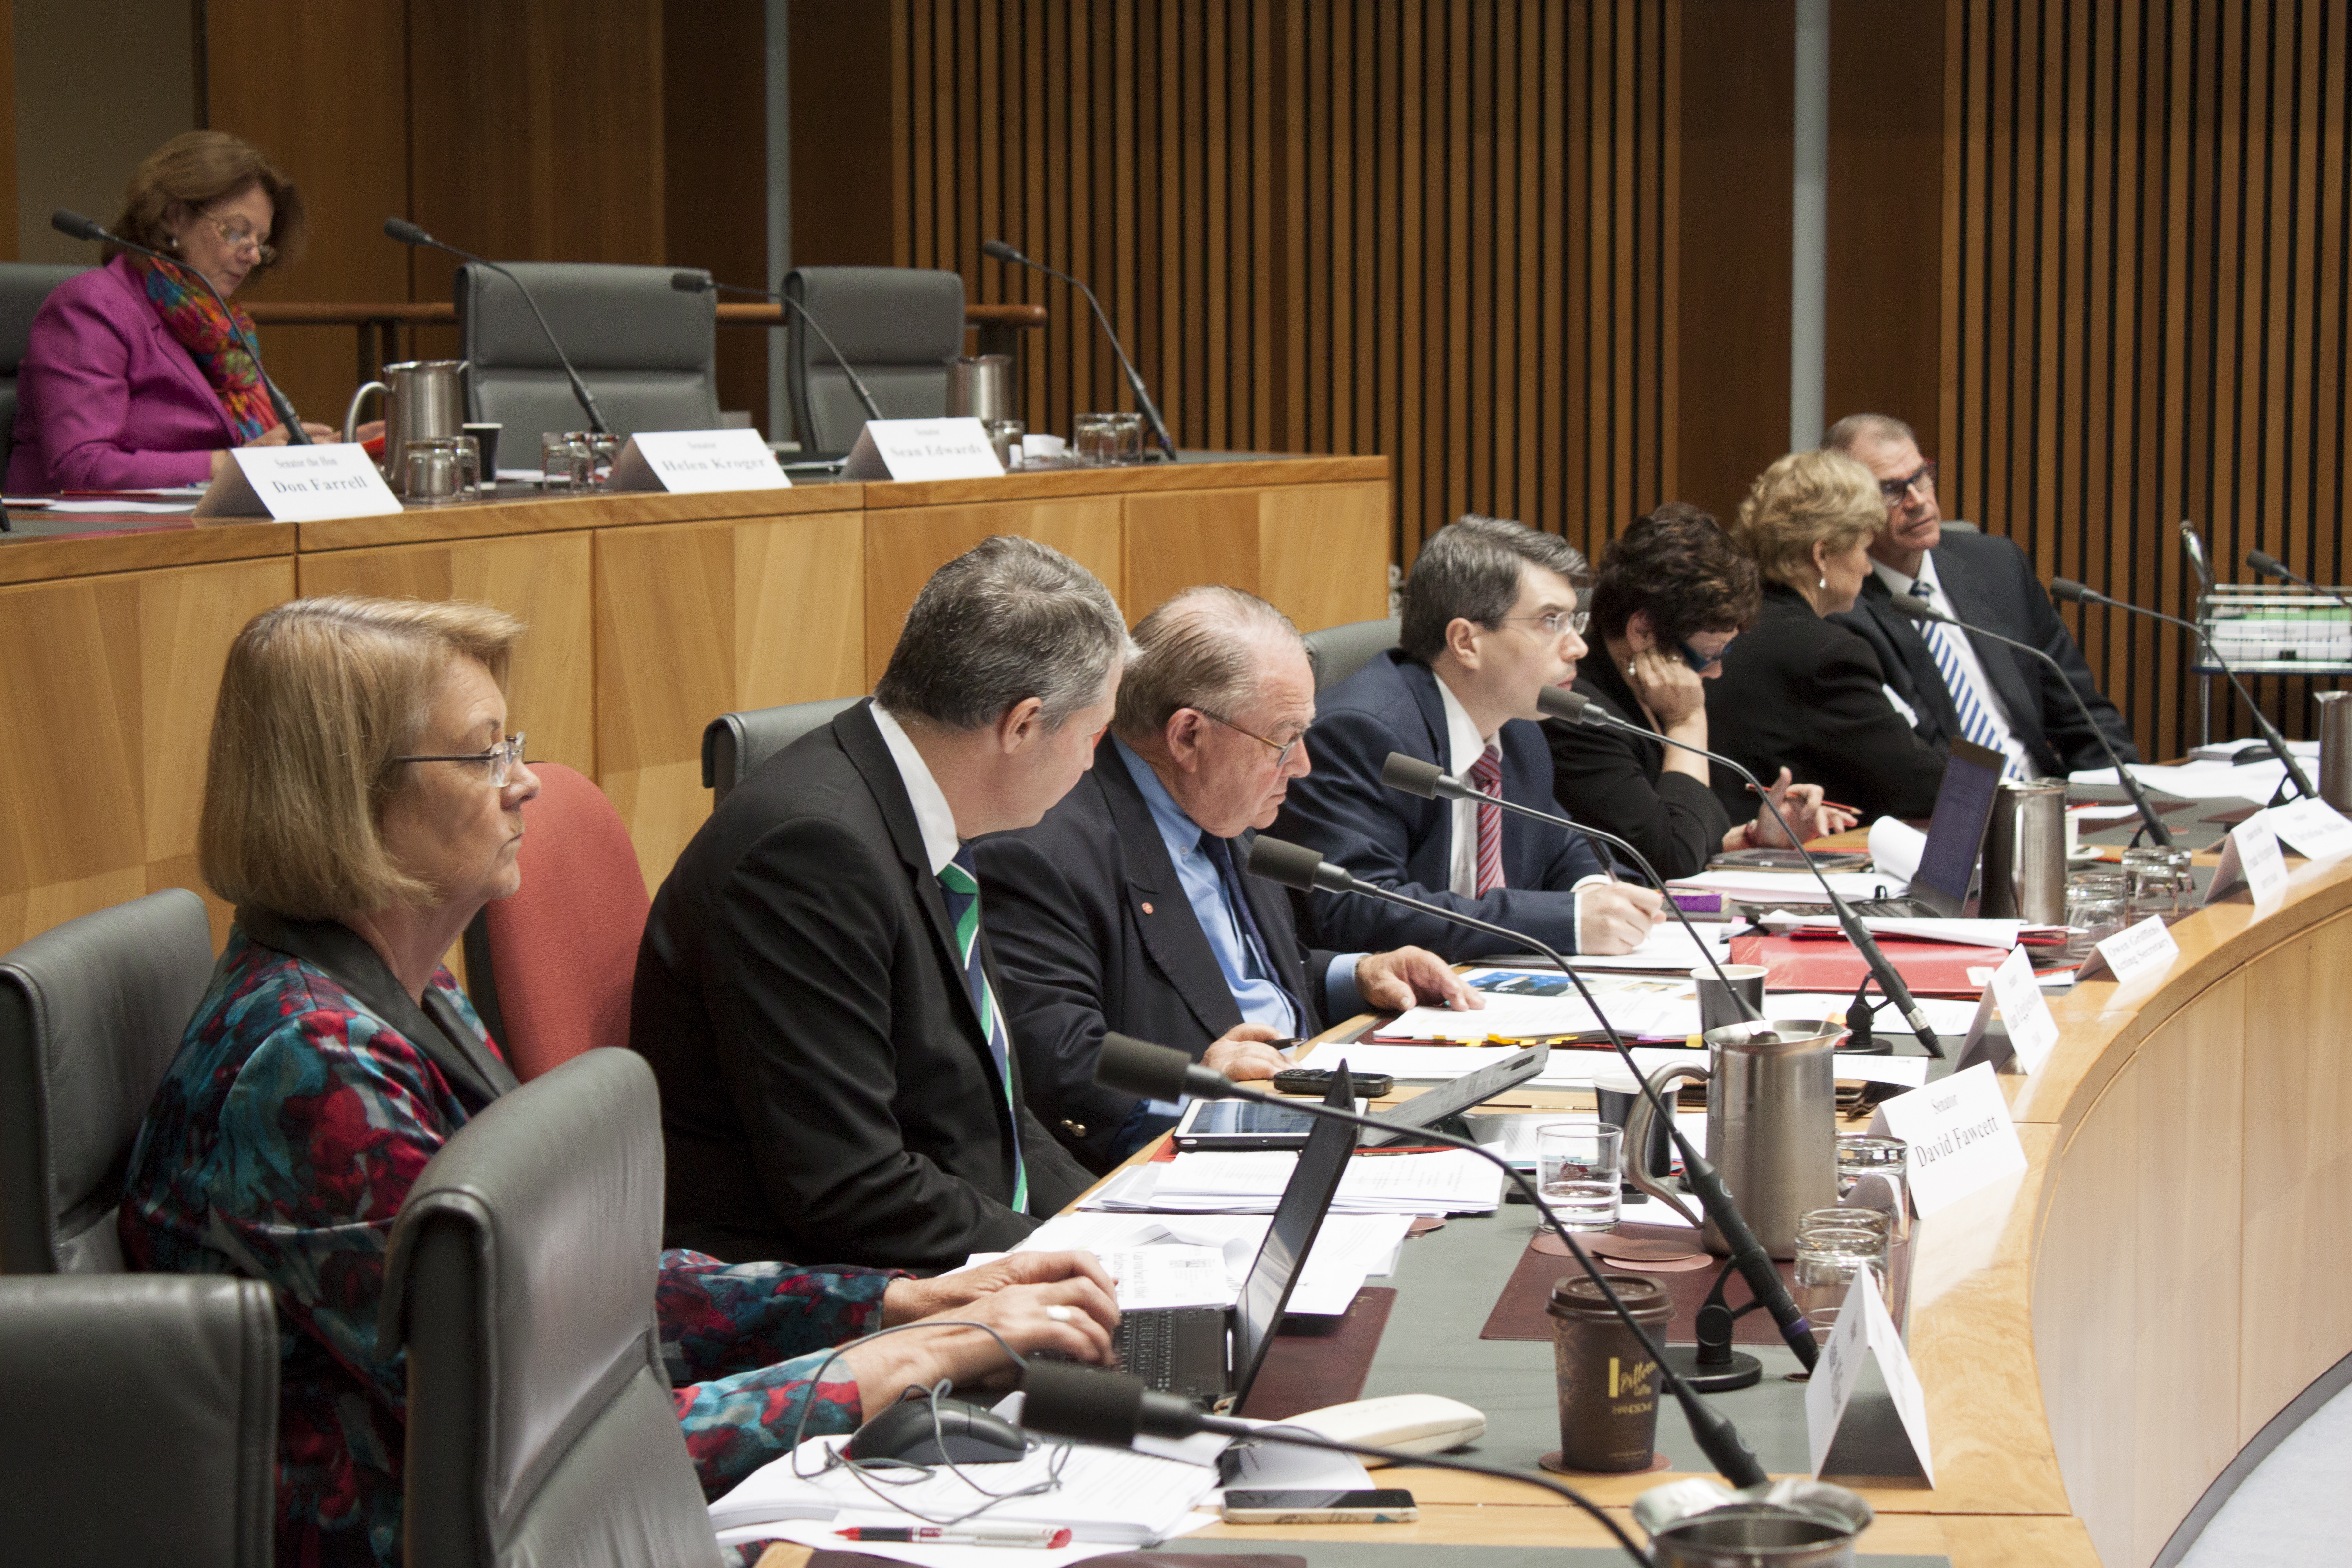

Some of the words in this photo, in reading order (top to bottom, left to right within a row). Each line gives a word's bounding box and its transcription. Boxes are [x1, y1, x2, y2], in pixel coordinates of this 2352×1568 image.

[890, 446, 922, 457] Sean
[925, 443, 982, 455] Edwards
[274, 458, 305, 468] Senator
[306, 457, 319, 467] the
[319, 455, 338, 466] Hon
[661, 459, 708, 471] Helen
[711, 458, 764, 470] Kroger
[271, 480, 308, 493] Don
[310, 475, 368, 490] Farrell
[1931, 1094, 1959, 1115] Senator
[1914, 1133, 1953, 1168] David
[1952, 1115, 1999, 1150] Fawcett
